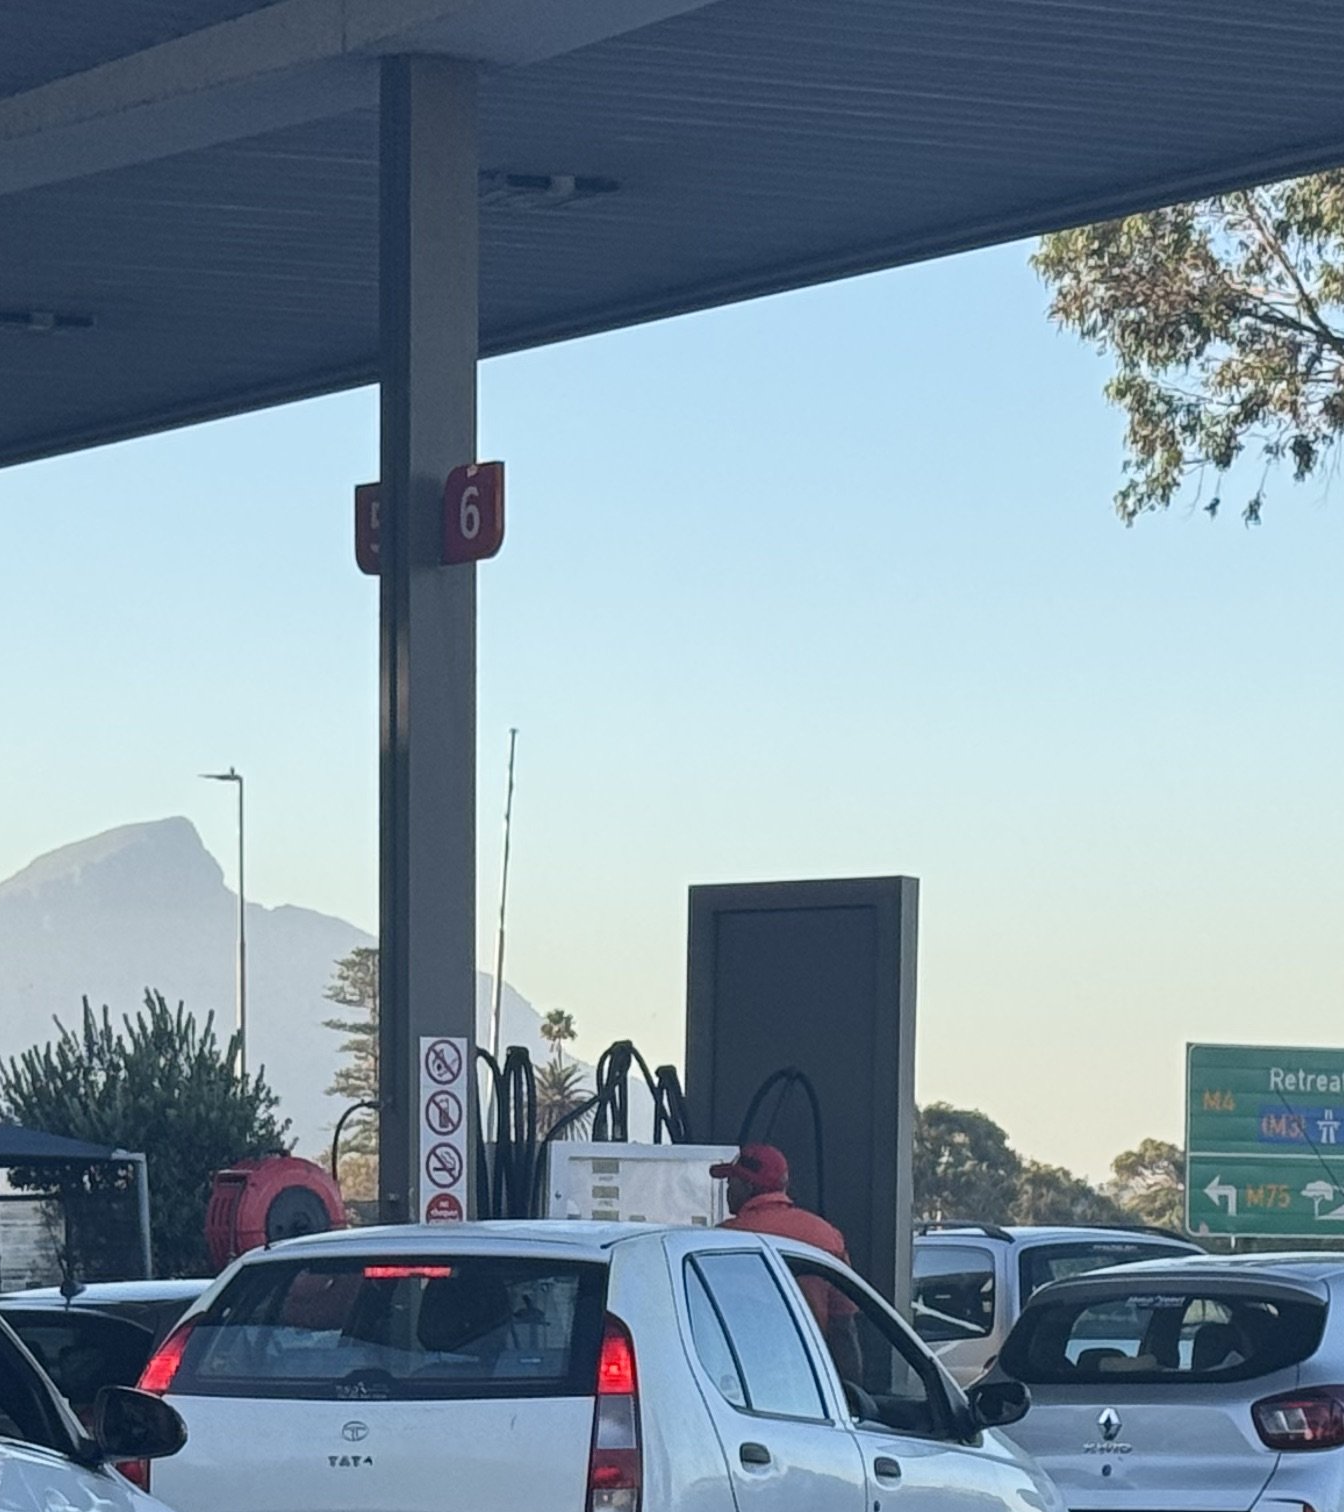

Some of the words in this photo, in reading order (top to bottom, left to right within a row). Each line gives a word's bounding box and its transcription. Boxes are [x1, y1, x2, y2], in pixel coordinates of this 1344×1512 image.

[460, 486, 480, 540] 6
[1202, 1090, 1236, 1111] M4
[1245, 1184, 1290, 1208] M75
